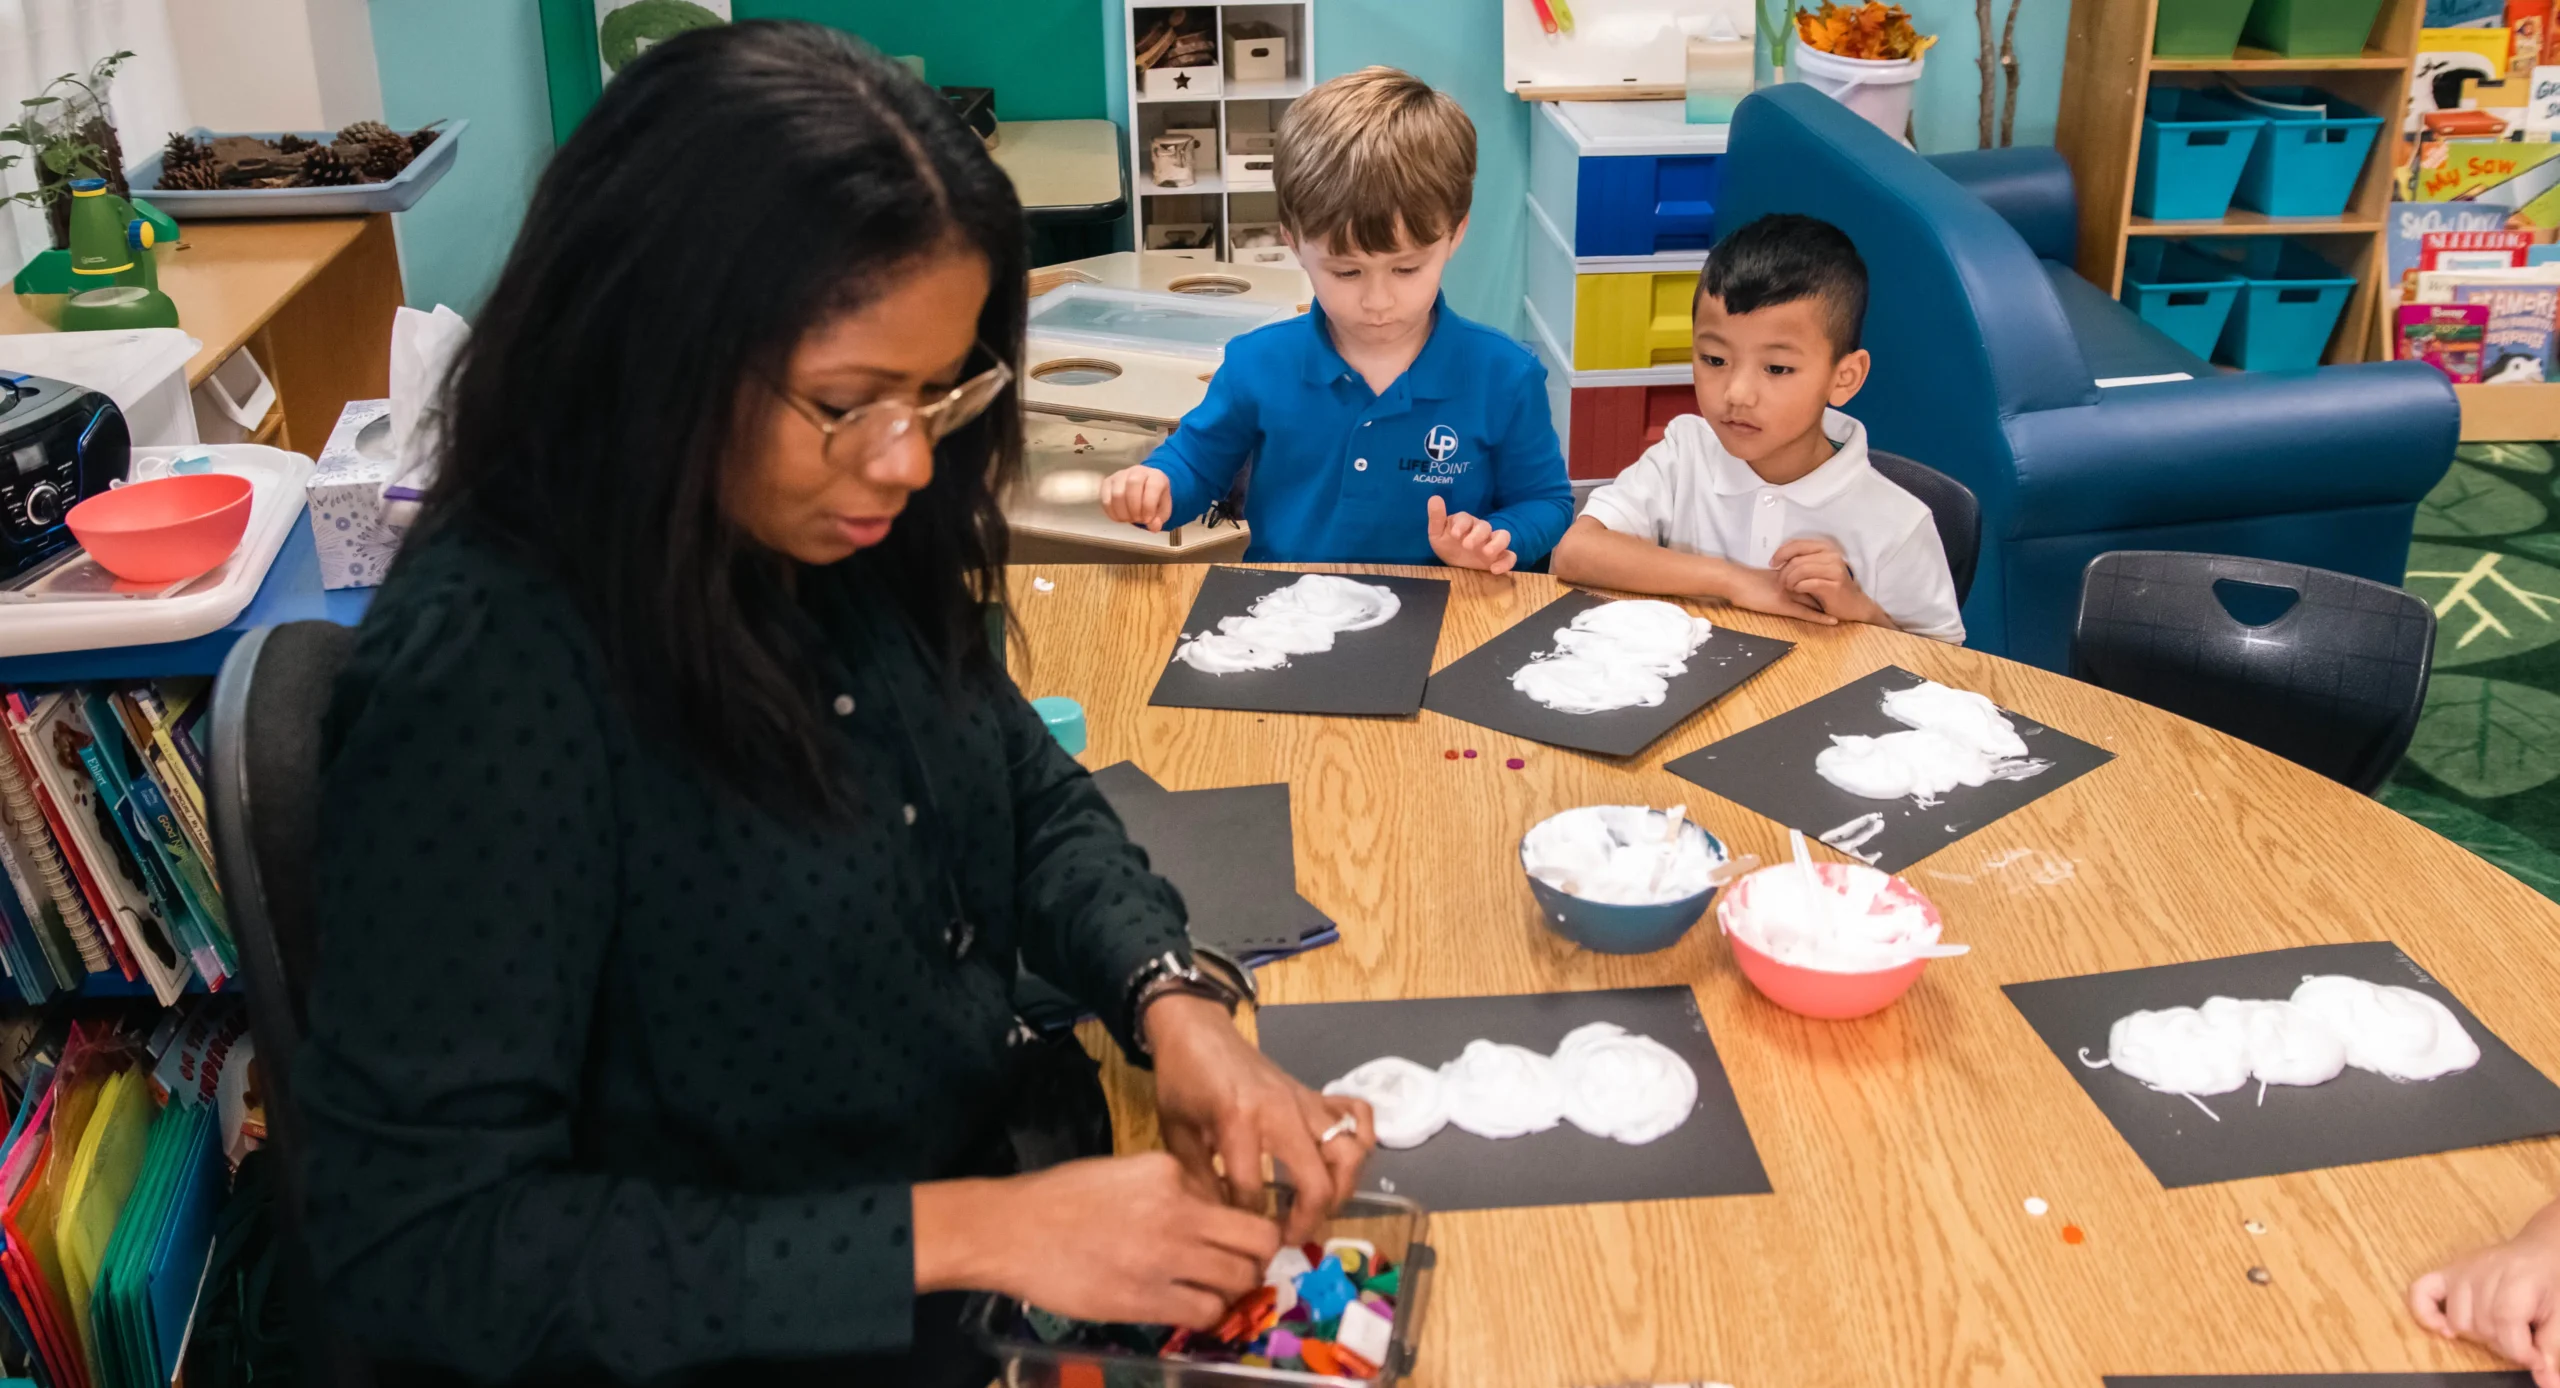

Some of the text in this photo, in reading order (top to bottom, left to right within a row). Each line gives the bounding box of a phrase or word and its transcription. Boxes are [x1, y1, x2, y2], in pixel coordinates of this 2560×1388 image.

[1428, 427, 1456, 461] LP
[1413, 474, 1455, 484] ACADEMY
[87, 757, 107, 786] Ehlert
[157, 814, 177, 839] Good
